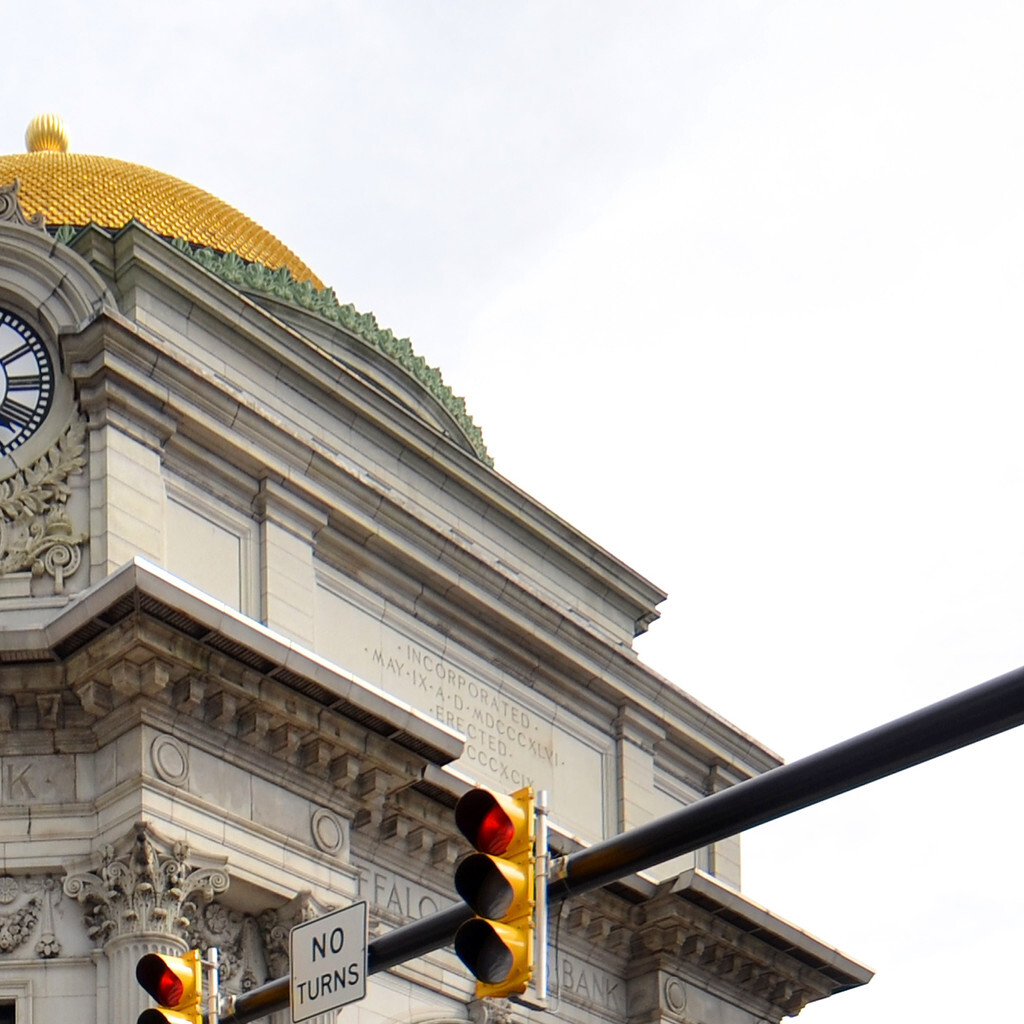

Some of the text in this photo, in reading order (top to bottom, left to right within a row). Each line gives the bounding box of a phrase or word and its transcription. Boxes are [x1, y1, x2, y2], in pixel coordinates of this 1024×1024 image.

[0, 342, 34, 366] II
[7, 375, 41, 392] III
[407, 645, 530, 729] INCORPORATED
[312, 927, 344, 962] NO
[296, 963, 359, 1005] TURNS
[562, 958, 621, 1009] BANK
